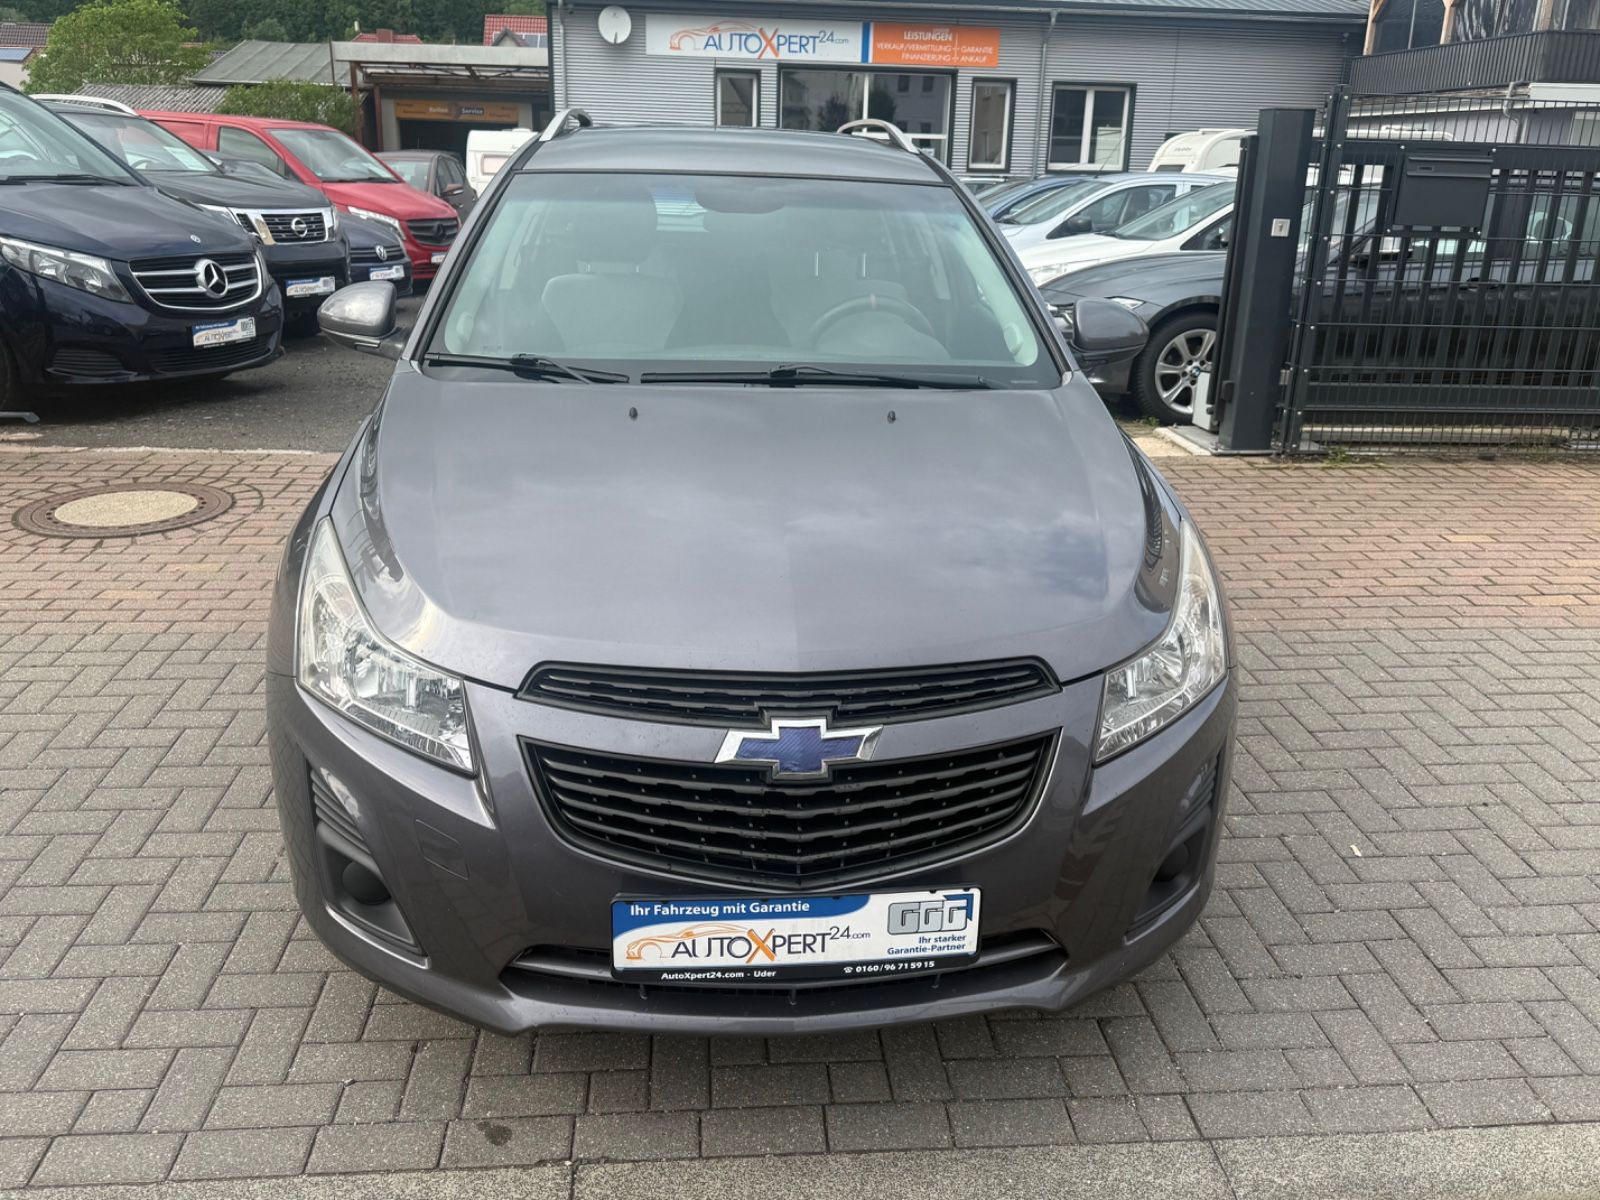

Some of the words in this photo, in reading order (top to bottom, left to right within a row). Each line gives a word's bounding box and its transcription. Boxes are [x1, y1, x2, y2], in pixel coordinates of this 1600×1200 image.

[903, 31, 953, 41] LEISTUNGEN
[960, 46, 993, 54] GARANTIE
[960, 55, 987, 63] ANKAUF
[630, 904, 651, 916] Ihr
[654, 903, 719, 917] Fahrzeug
[722, 902, 746, 914] mit
[749, 900, 810, 913] Garantie
[918, 936, 932, 944] Ihr
[933, 934, 967, 943] starker
[887, 943, 966, 955] Garantie-Partner
[661, 971, 744, 980] AutoXpert24.com
[753, 970, 777, 978] Uder
